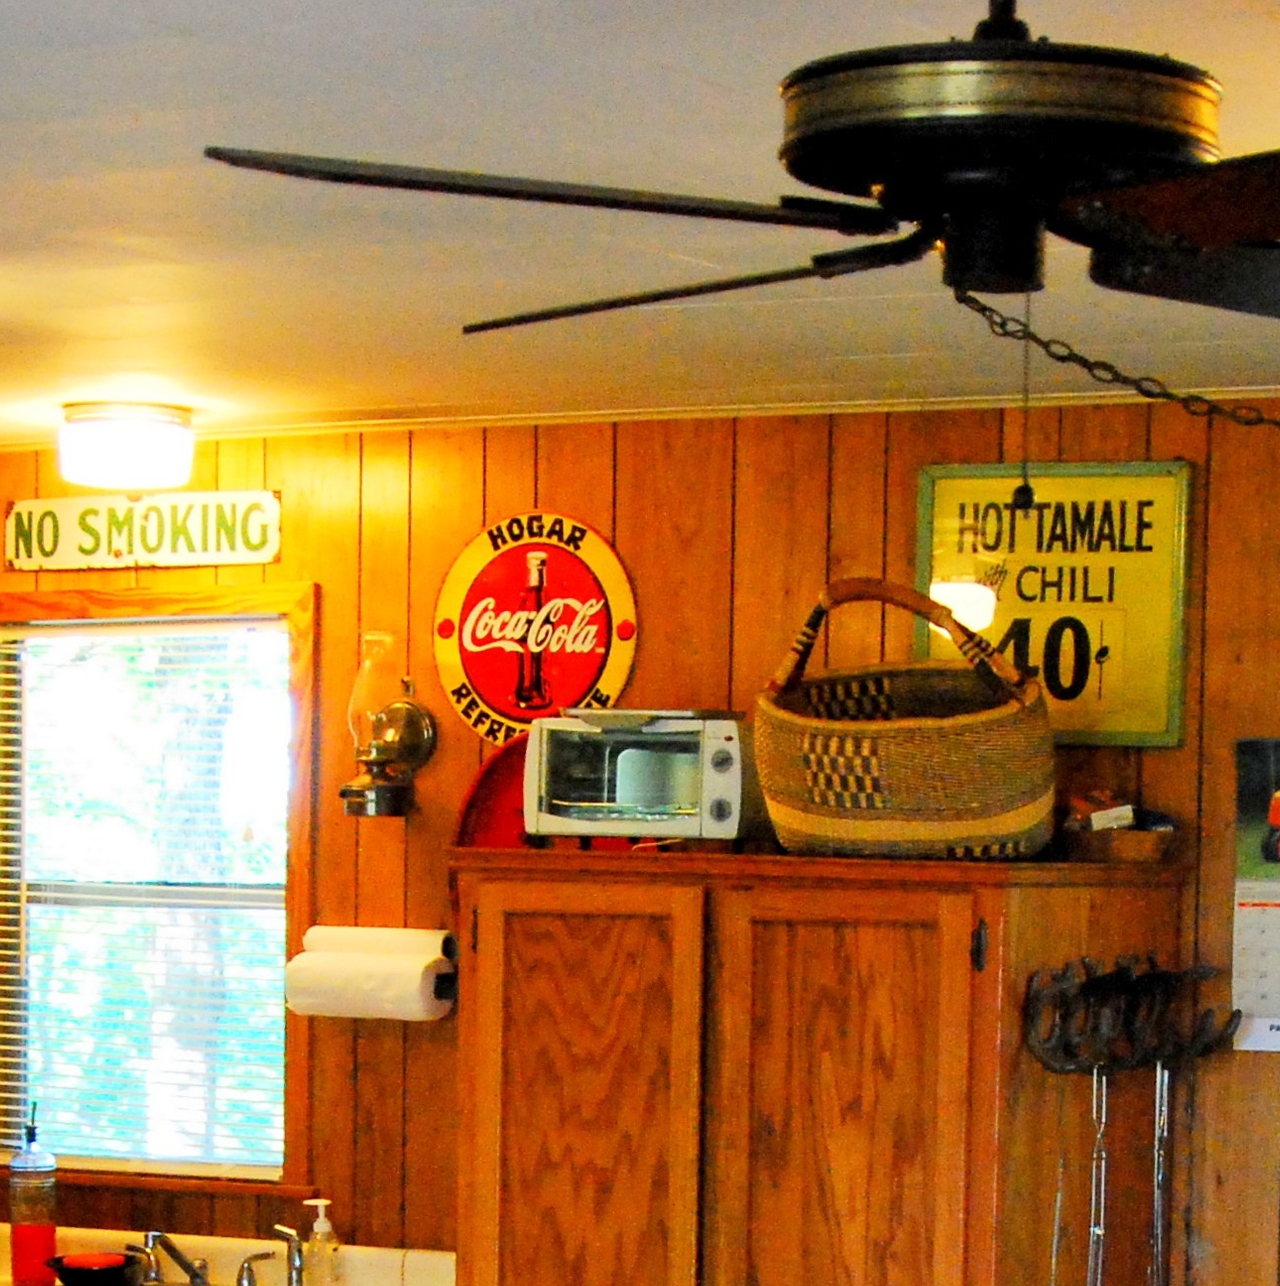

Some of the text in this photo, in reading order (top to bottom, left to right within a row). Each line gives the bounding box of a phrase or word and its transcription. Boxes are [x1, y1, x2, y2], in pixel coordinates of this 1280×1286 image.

[15, 502, 269, 559] NO SMOKING
[487, 514, 588, 551] HOGAR
[958, 499, 1154, 553] HOT TAMALE
[1016, 565, 1116, 603] CHILI
[462, 597, 605, 653] Coca-Cola
